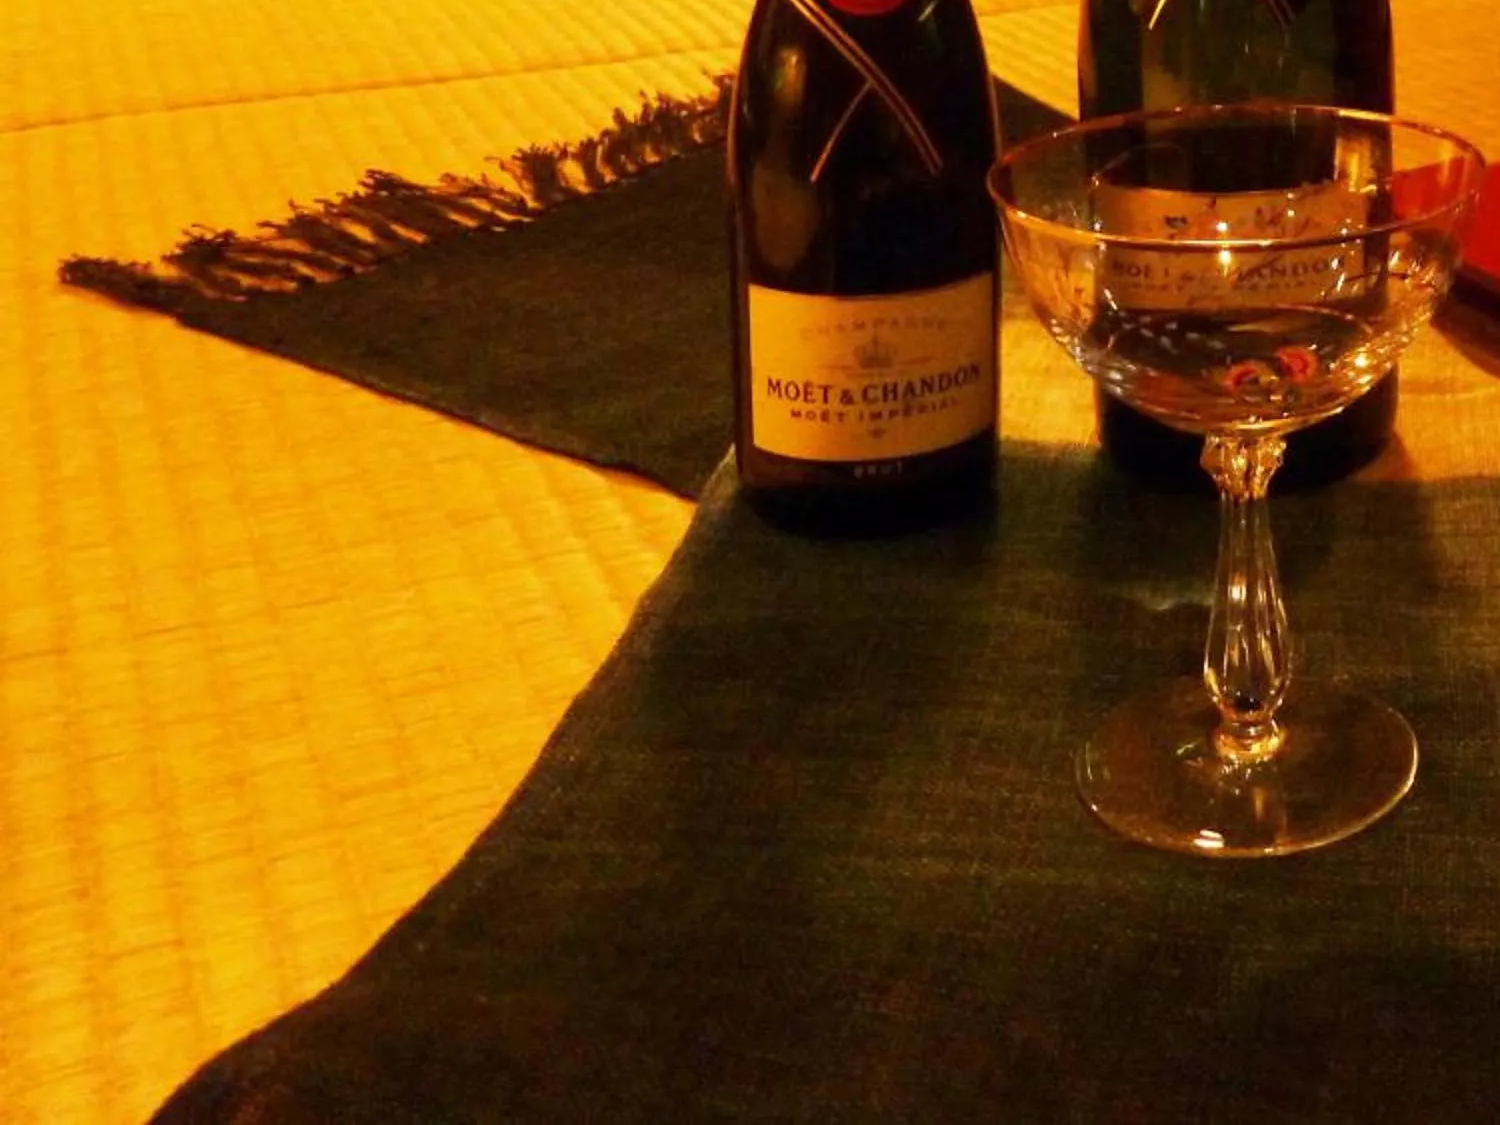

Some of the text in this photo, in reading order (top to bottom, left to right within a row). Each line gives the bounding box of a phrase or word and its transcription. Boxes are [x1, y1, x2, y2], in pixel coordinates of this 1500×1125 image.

[767, 362, 981, 406] MOËT & CHANDON
